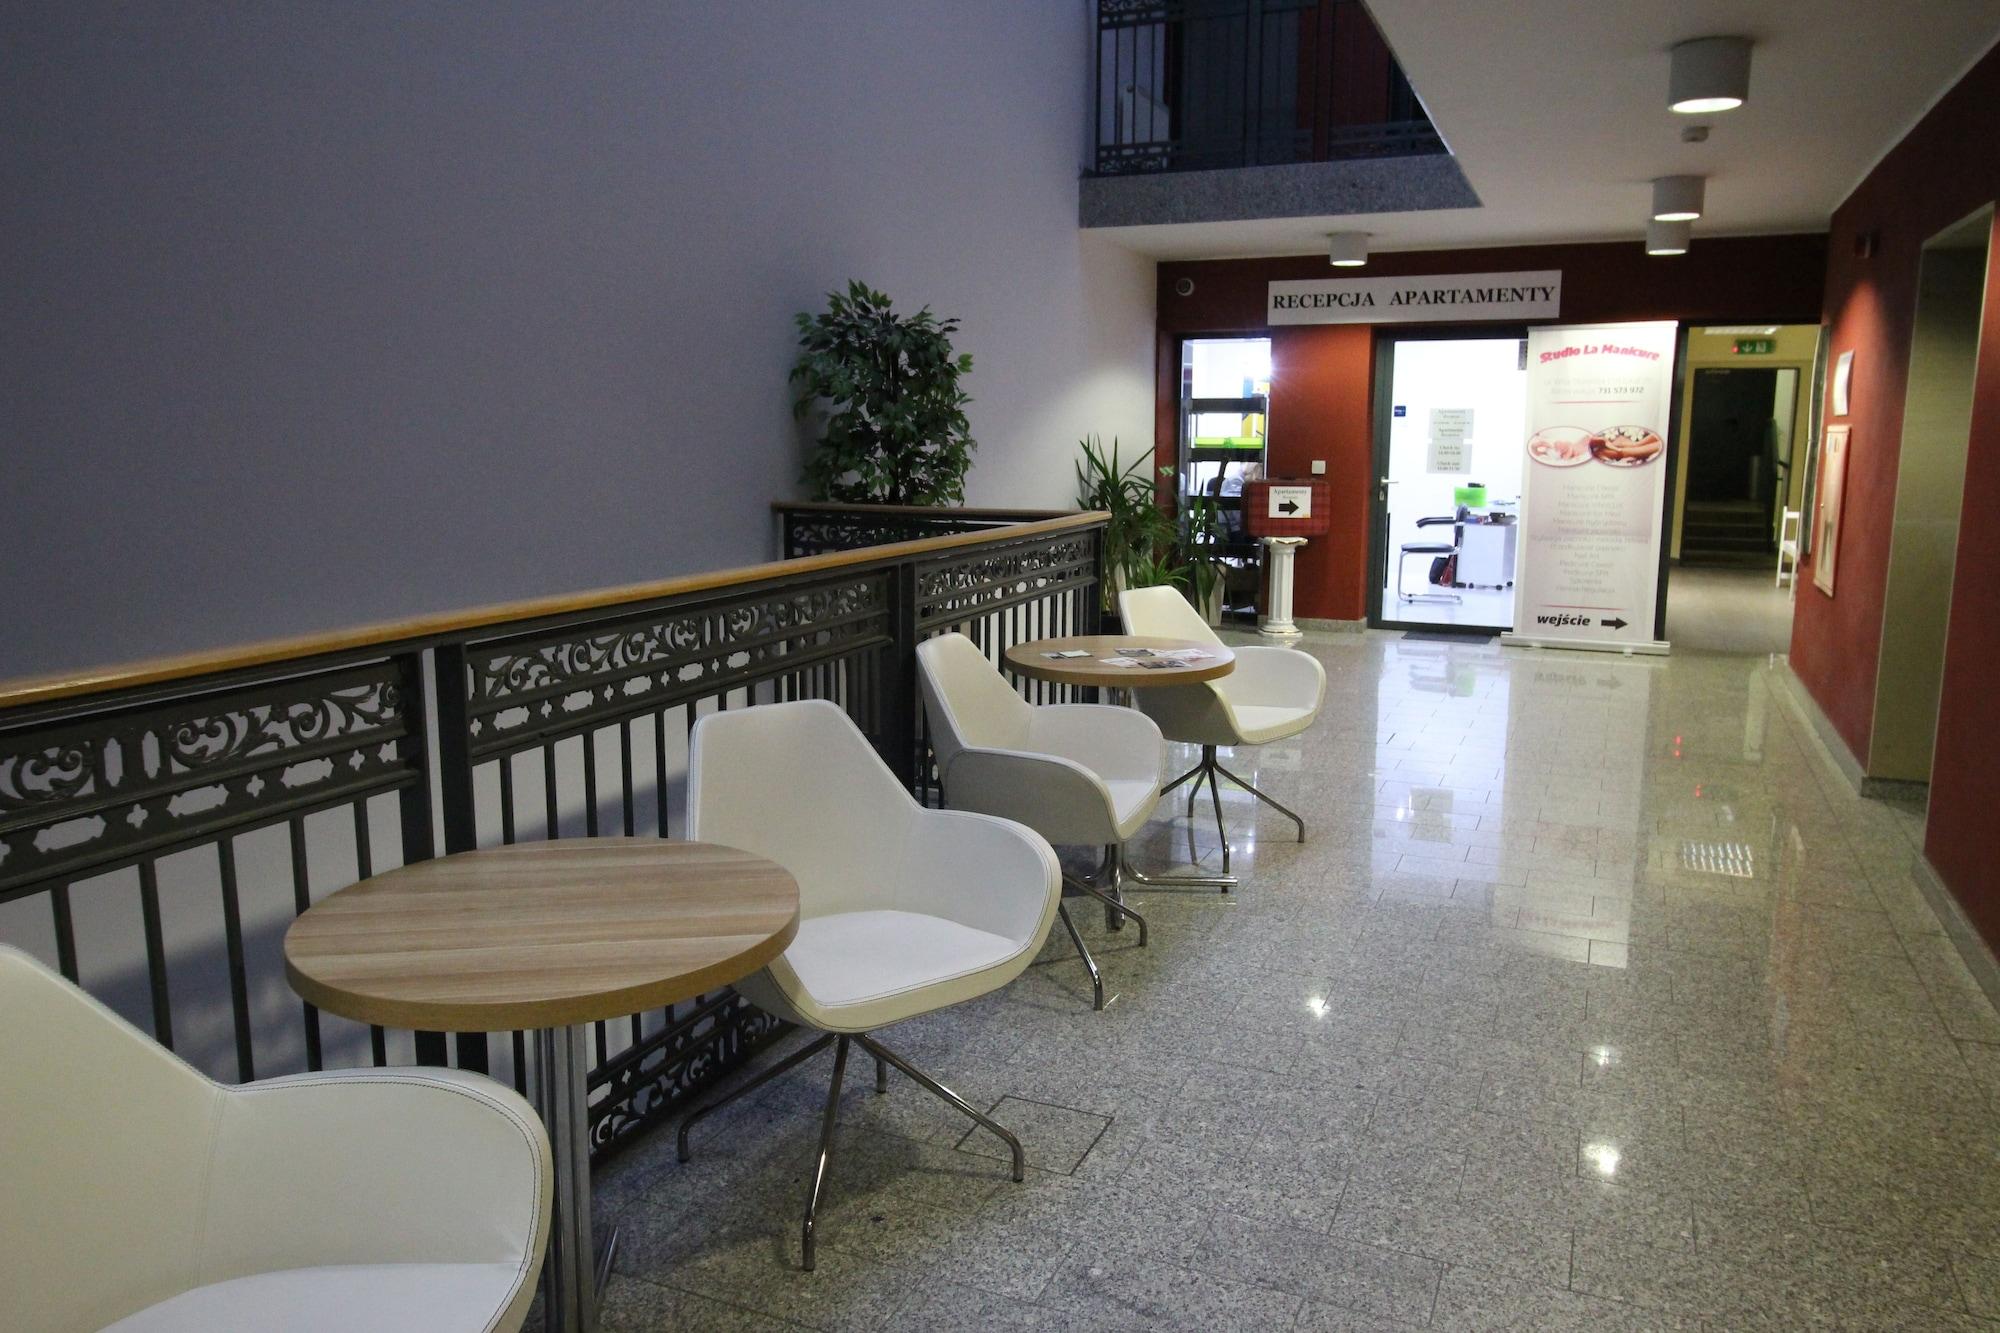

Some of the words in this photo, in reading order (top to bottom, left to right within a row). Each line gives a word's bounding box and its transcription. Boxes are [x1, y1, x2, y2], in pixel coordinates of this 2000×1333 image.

[1272, 291, 1375, 310] RECEPCJA
[1389, 286, 1556, 306] APARTAMENTY
[1540, 347, 1580, 363] Studio
[1583, 345, 1598, 355] La
[1601, 344, 1660, 361] Manicure
[1537, 614, 1591, 627] wejście
